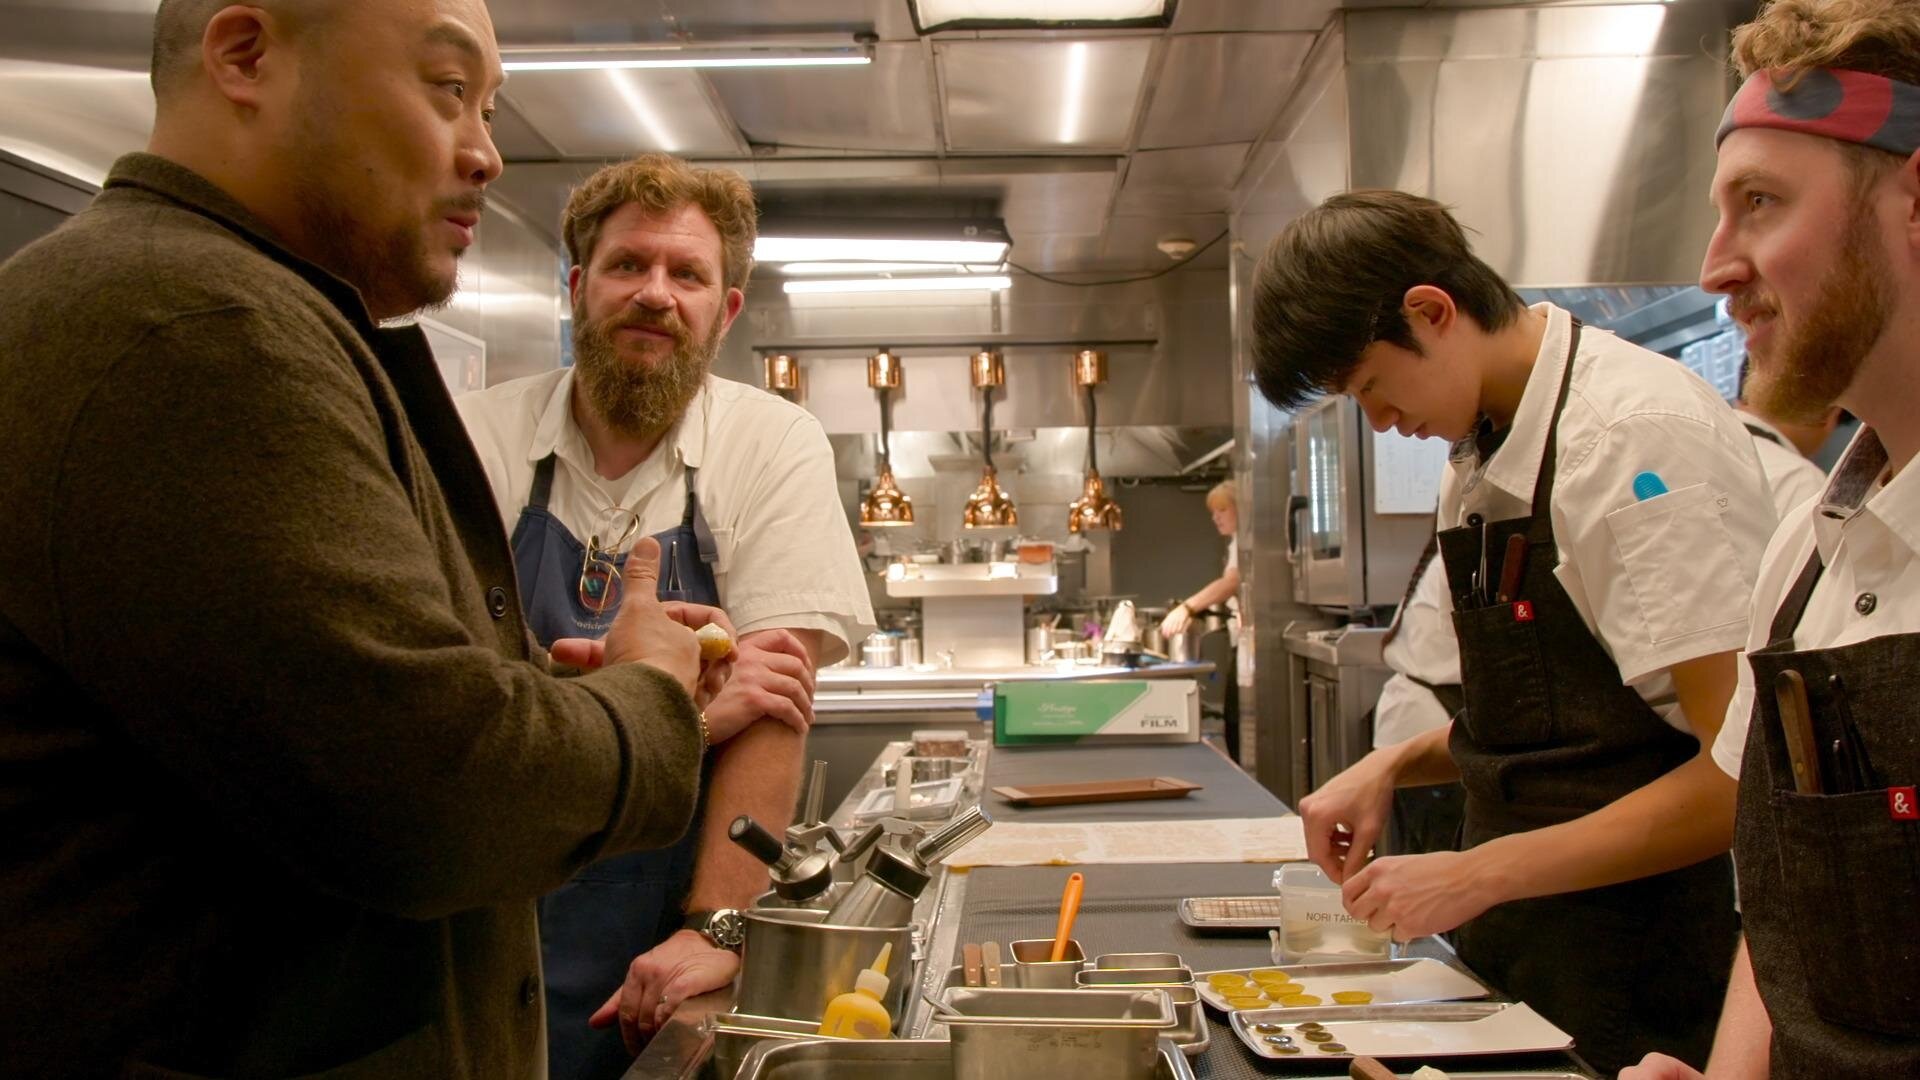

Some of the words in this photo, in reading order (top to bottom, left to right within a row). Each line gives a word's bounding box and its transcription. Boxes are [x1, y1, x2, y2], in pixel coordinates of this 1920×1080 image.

[1140, 719, 1178, 728] FILM
[1894, 792, 1911, 814] &
[1306, 912, 1332, 922] NORI
